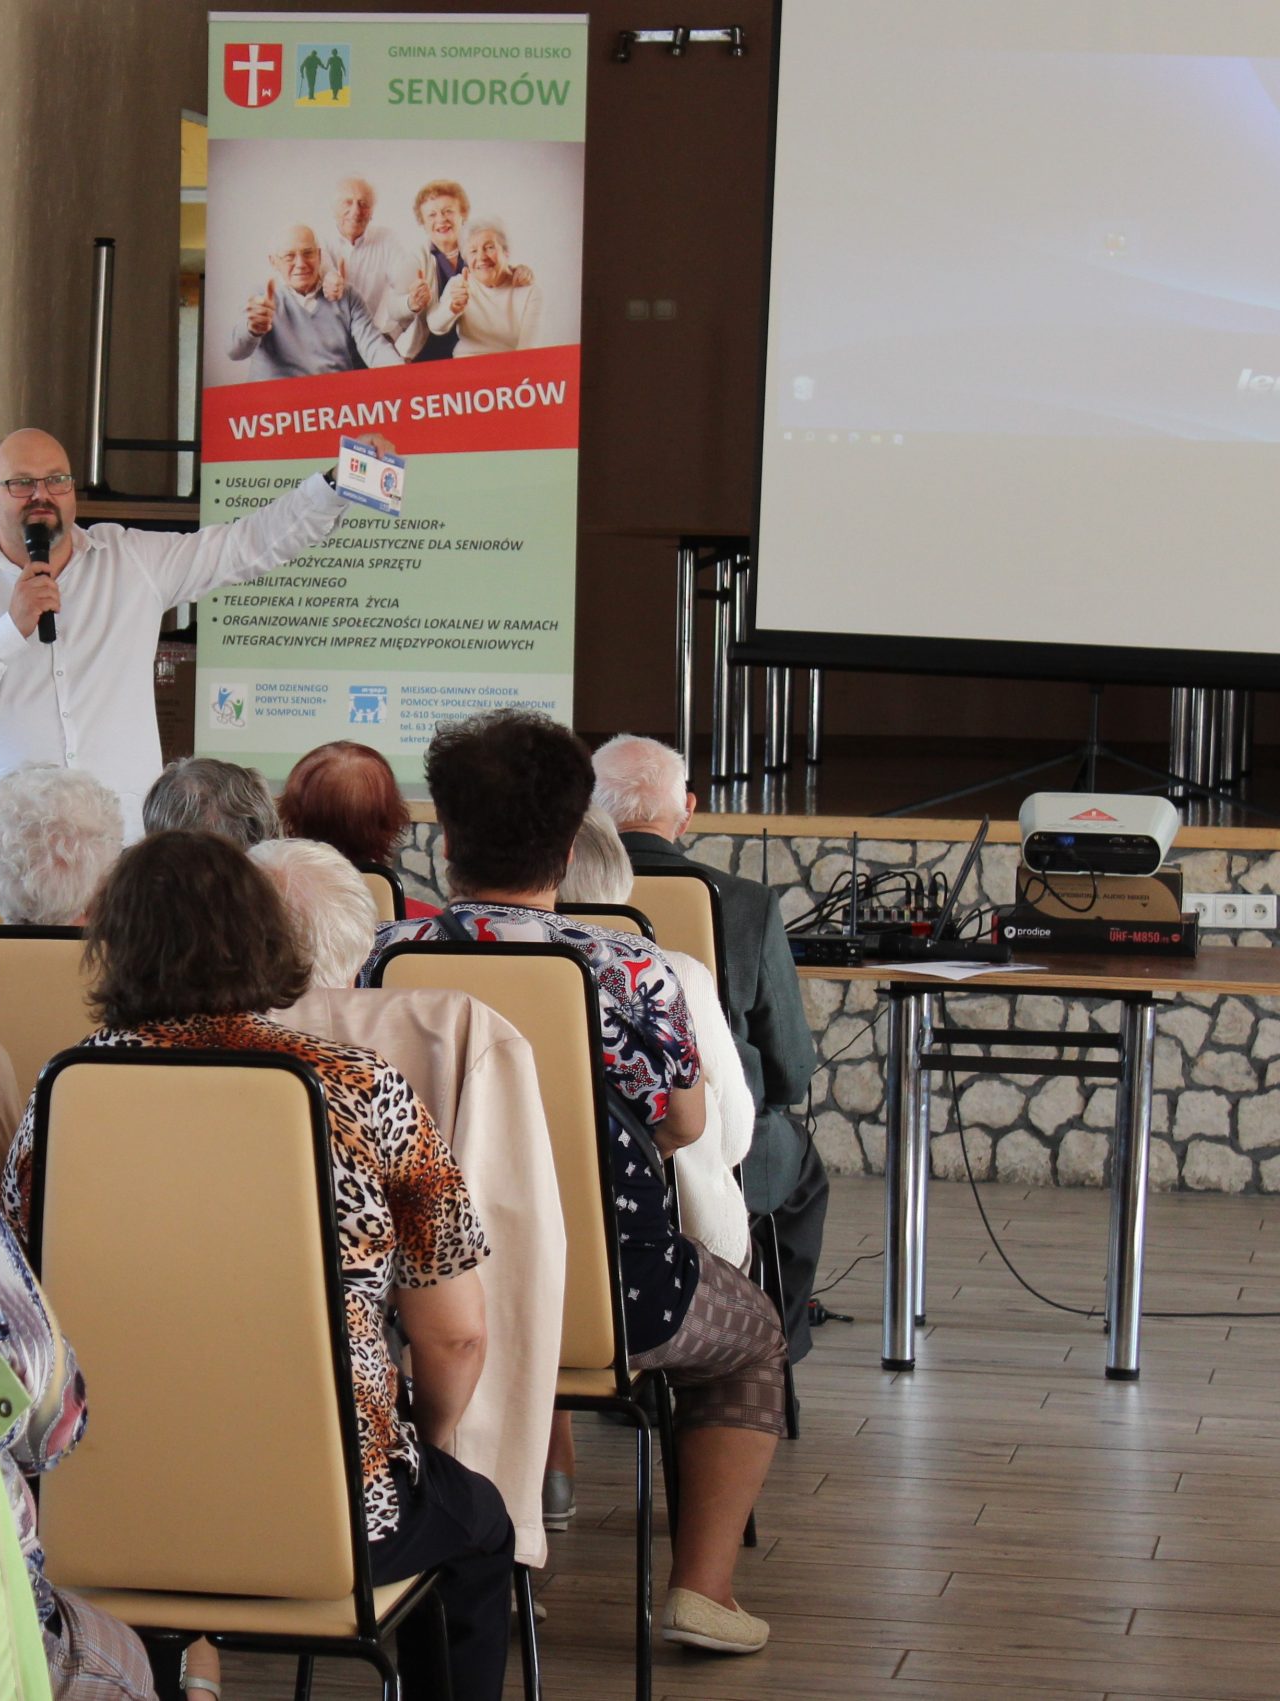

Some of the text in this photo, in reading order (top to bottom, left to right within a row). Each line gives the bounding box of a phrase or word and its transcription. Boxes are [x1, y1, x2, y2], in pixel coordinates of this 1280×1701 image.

[388, 46, 571, 59] GMINA SOMPOLNO BLISKO
[388, 72, 570, 106] SENIORÓW
[1237, 368, 1280, 390] le
[228, 377, 566, 440] WSPIERAMY SENIORÓW
[225, 478, 302, 489] USŁUGI OPIE
[225, 494, 276, 508] OŚRODE
[341, 518, 446, 530] POBYTU SENIOR+
[320, 537, 524, 551] SPECJALISTYCZNE DLA SENIORÓW
[283, 555, 422, 571] POŻYCZANIA SPRZĘTU
[232, 577, 348, 588] ABILITACYJNEGO
[223, 594, 400, 609] TELEOPIEKA I KOPERTA ŻYCIA
[223, 614, 559, 631] ORGANIZOWANIE SPOŁECZNOŚCI LOKALNEJ W RAMACH
[222, 635, 535, 651] INTEGRACYJNYCH IMPREZ MIĘDZYPOKOLENIOWYCH
[255, 684, 329, 693] DOM DZIENNEGO
[400, 685, 519, 696] MIEJSKO-GMINNY OŚRODEK
[255, 695, 289, 704] POBYTU
[400, 698, 439, 706] POMOCY
[441, 699, 491, 707] SPOŁECZNEJ
[255, 708, 316, 717] W SOMPOLNIE
[400, 711, 429, 719] 62-610
[400, 735, 431, 744] sekreta
[1017, 927, 1051, 937] prodipe
[1109, 930, 1160, 943] UHF-M850
